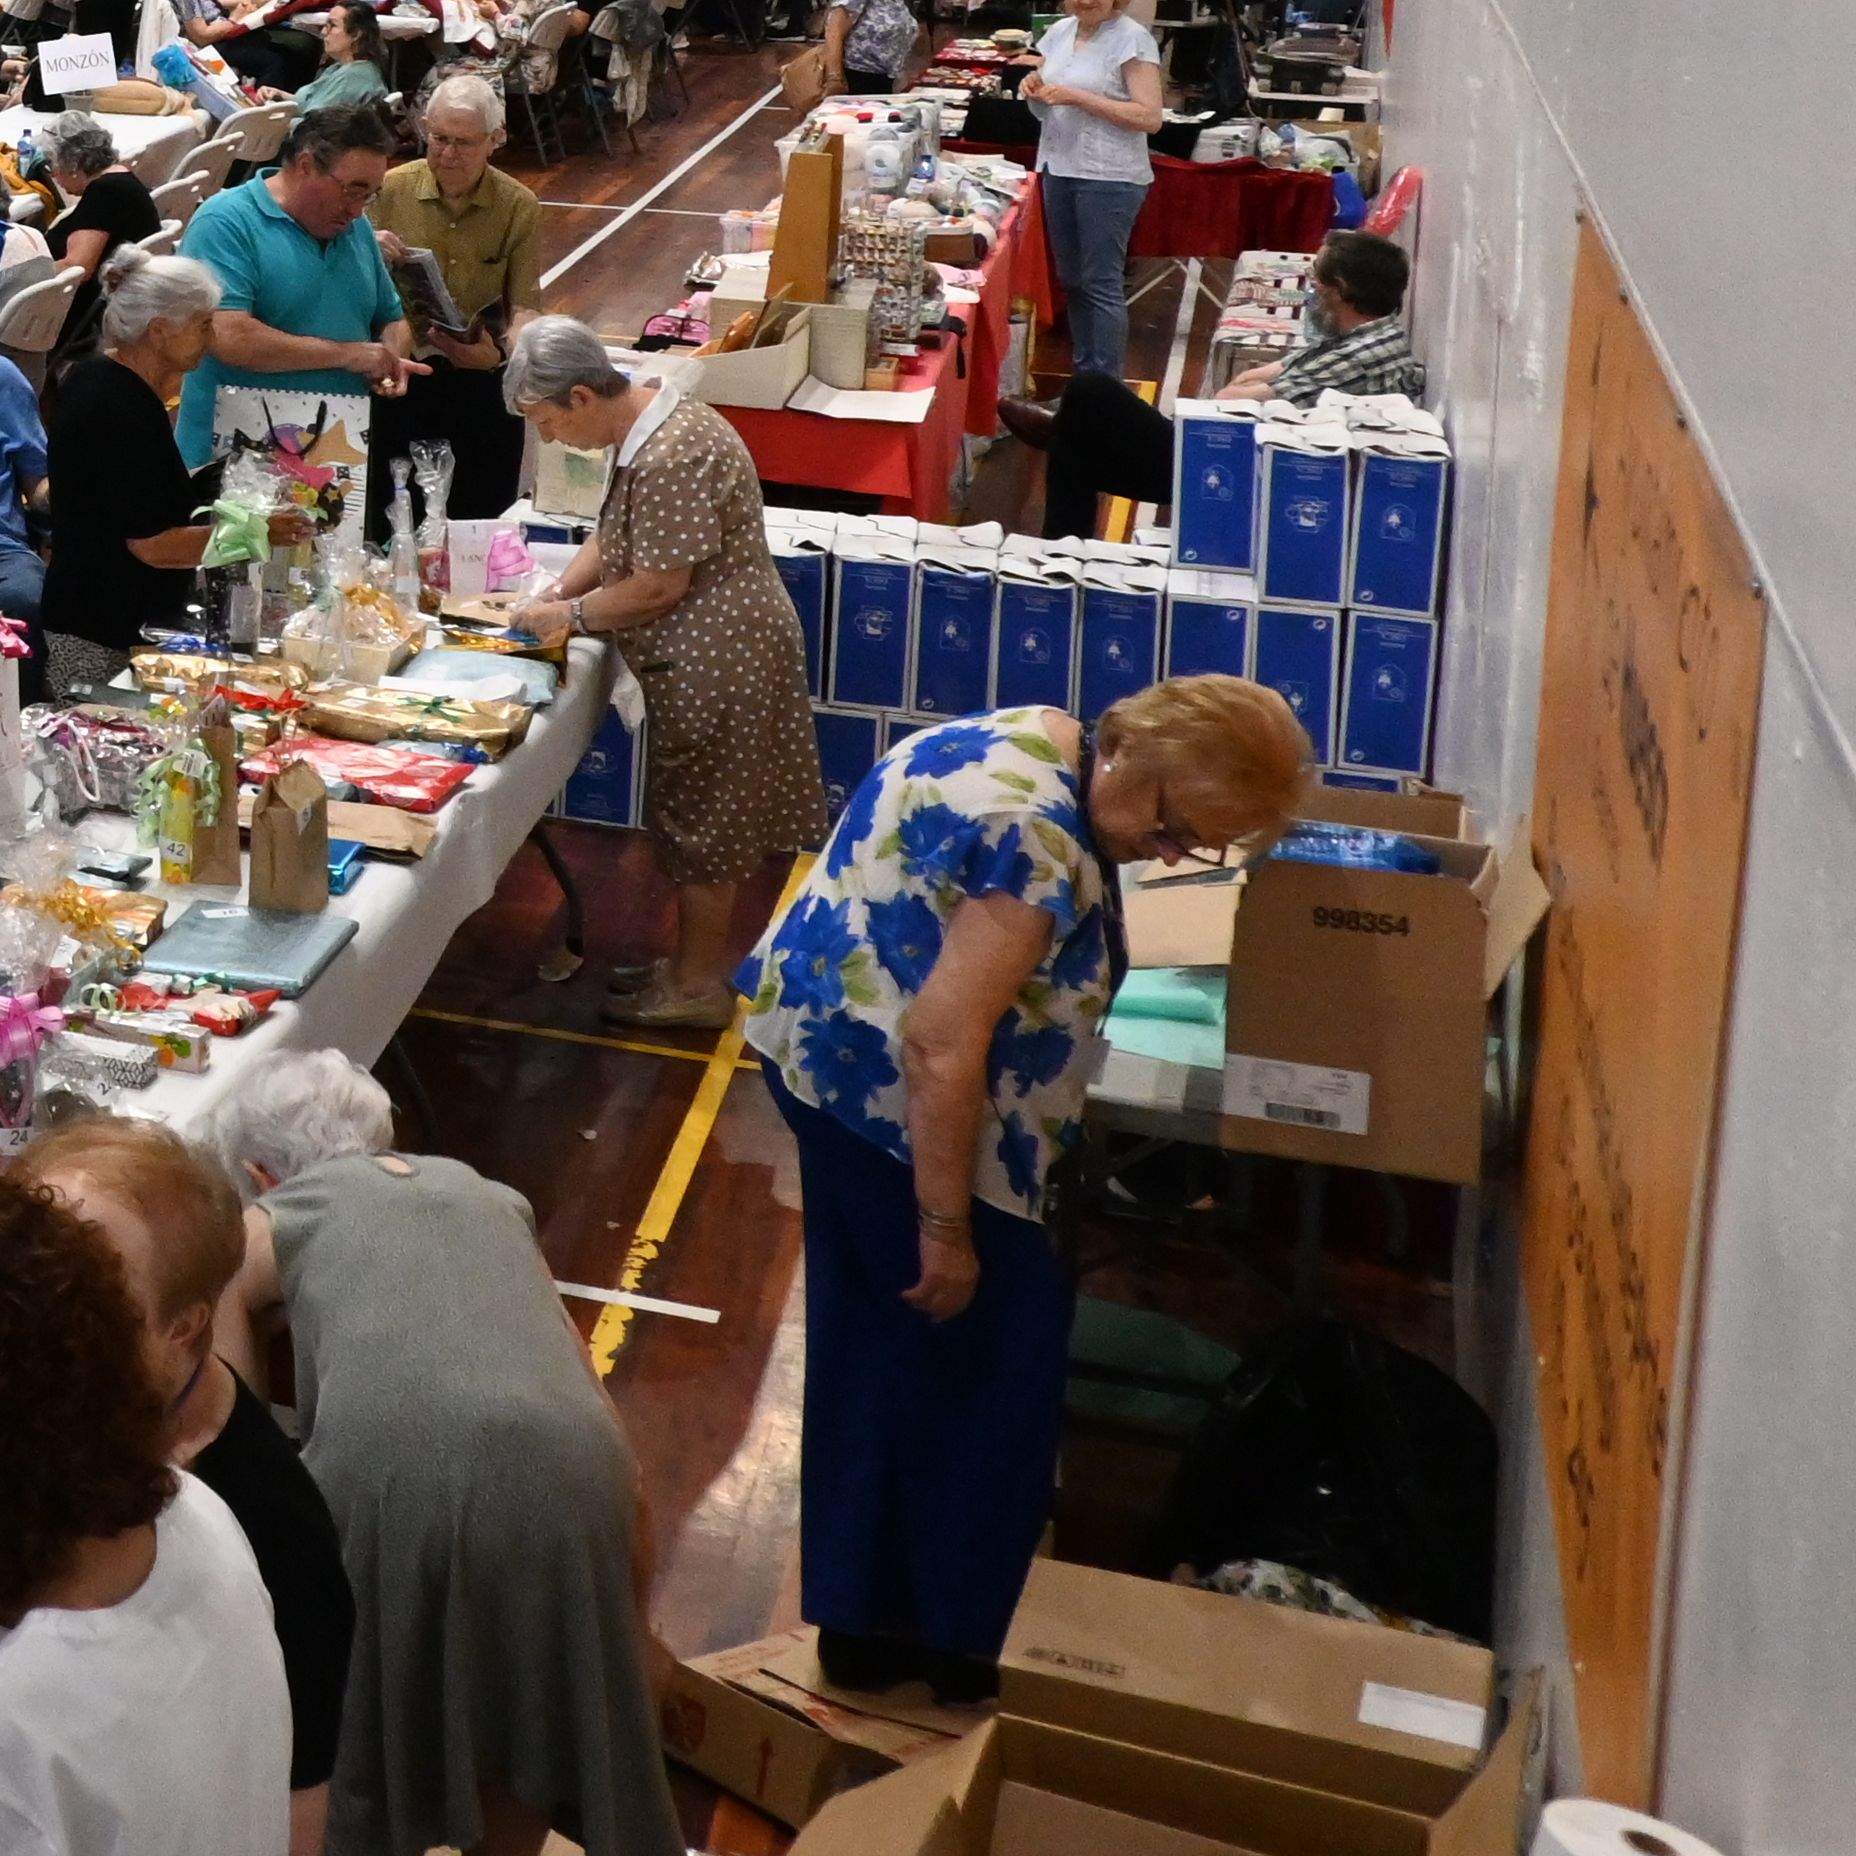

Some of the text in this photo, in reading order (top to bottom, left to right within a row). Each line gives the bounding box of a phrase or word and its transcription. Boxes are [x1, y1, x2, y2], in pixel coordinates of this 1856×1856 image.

[45, 49, 110, 73] MONZÓN
[166, 843, 186, 857] 42
[10, 1130, 28, 1145] 24
